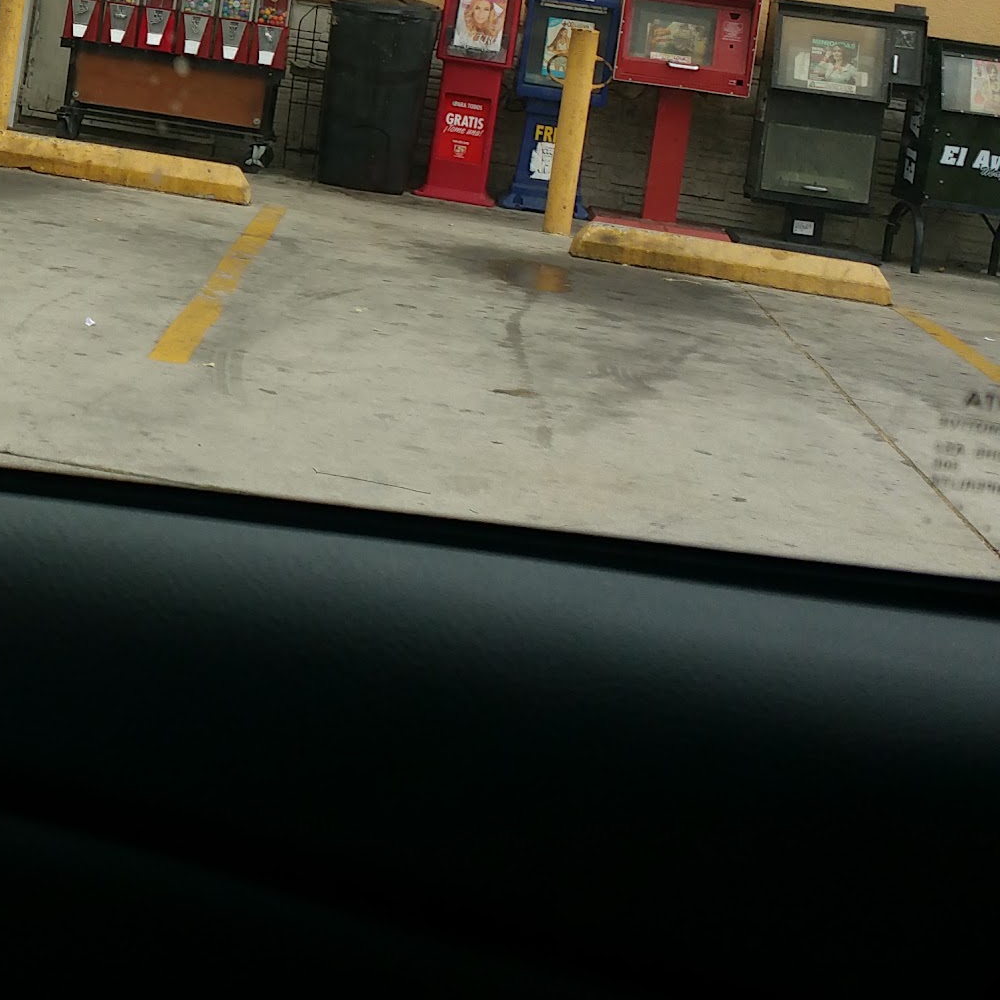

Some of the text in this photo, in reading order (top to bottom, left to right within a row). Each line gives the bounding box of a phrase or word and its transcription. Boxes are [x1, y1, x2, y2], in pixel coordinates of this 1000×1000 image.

[445, 112, 484, 130] GRATIS
[534, 124, 558, 143] FR
[940, 145, 968, 167] El
